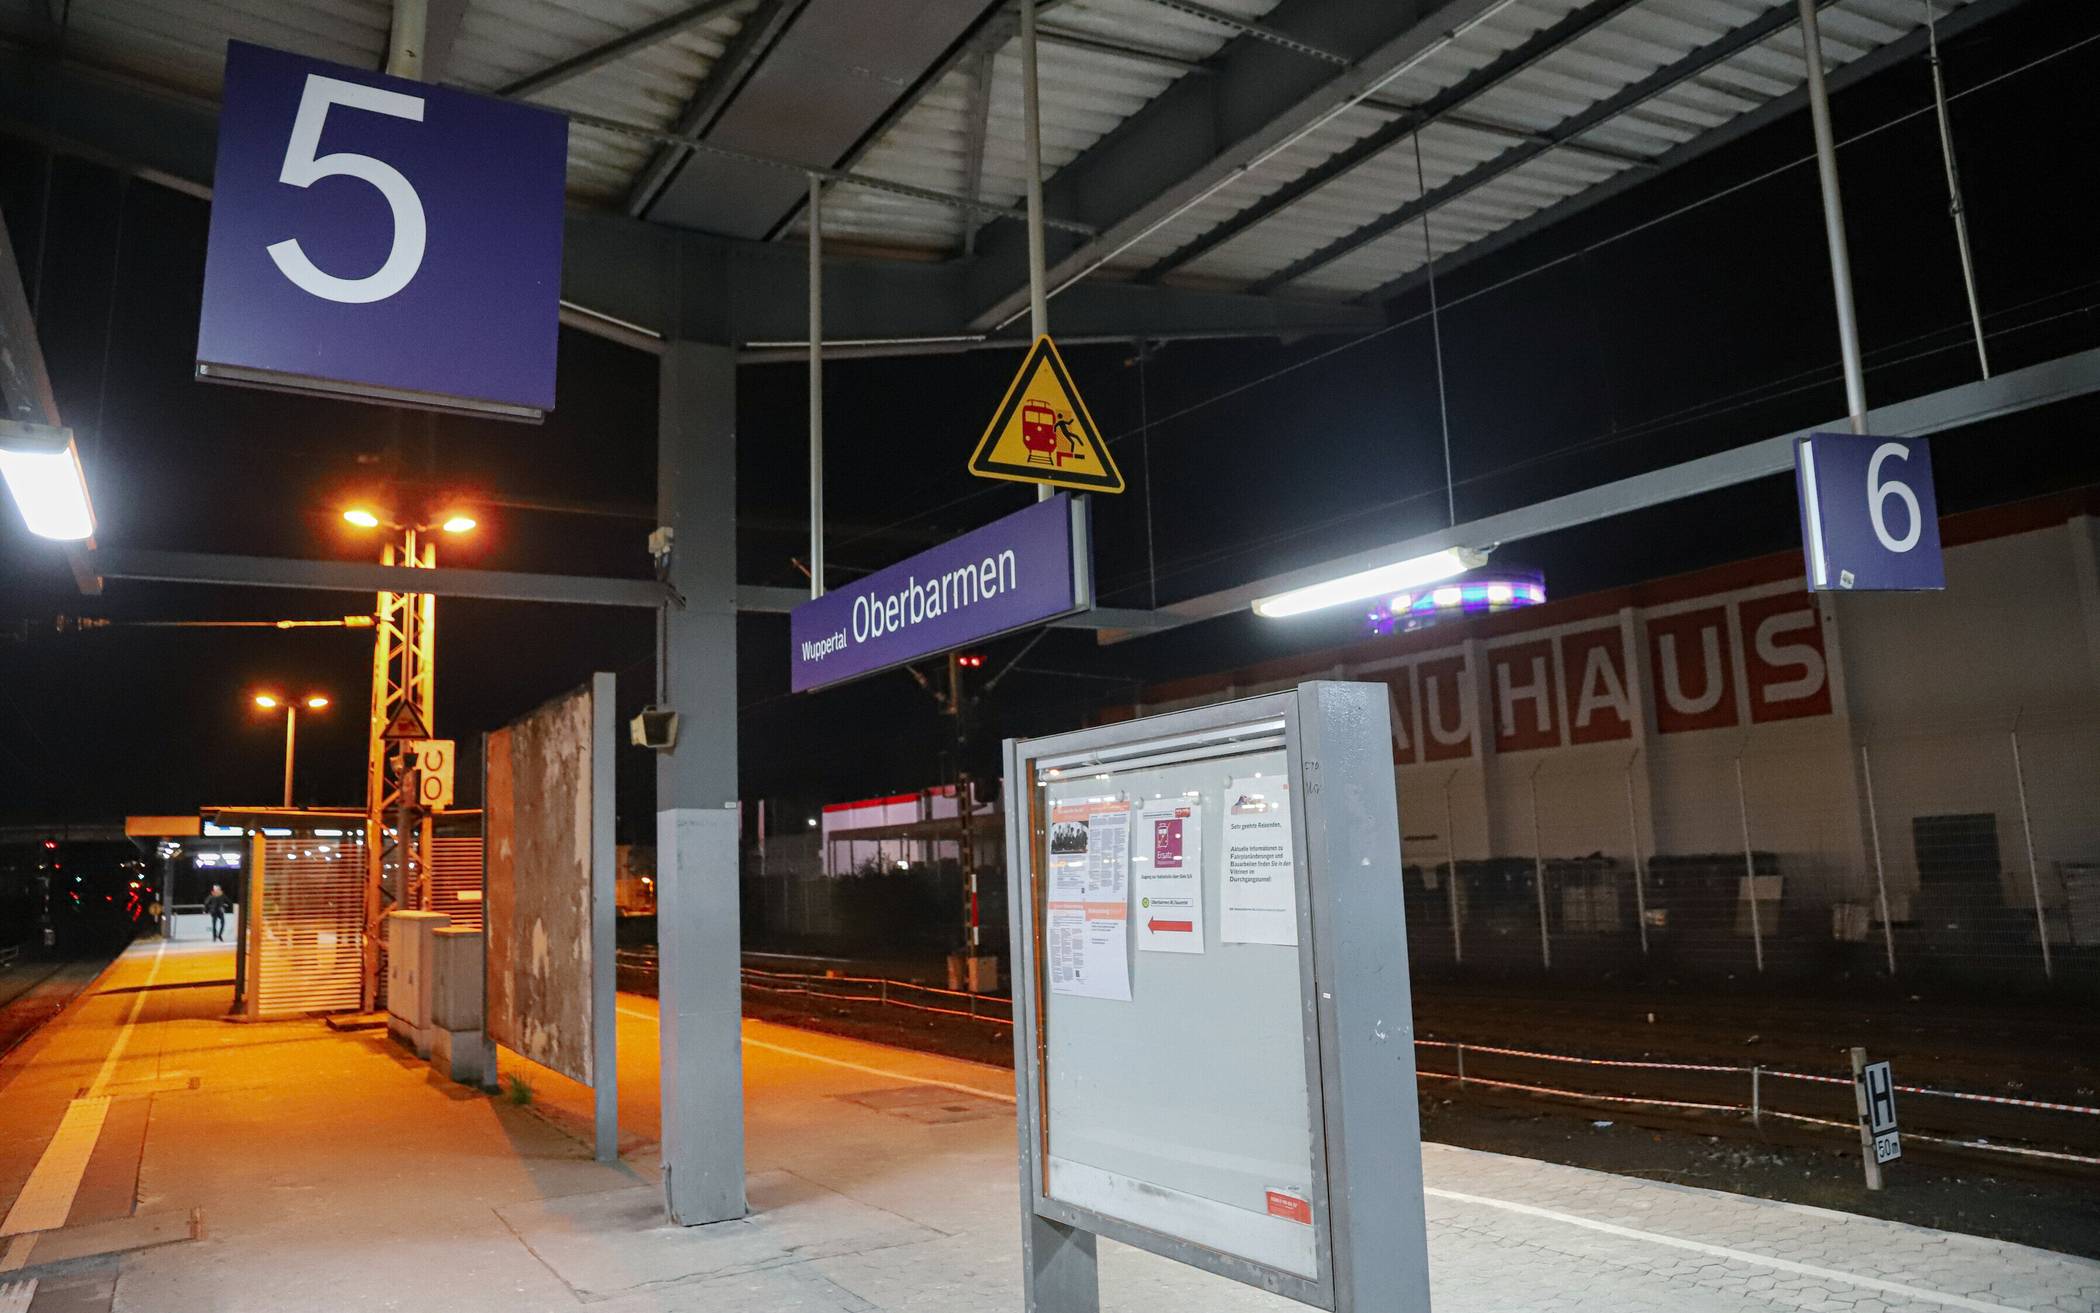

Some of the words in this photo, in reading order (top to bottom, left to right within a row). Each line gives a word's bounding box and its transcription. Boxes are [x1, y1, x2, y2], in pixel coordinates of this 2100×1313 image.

[266, 75, 427, 304] 5
[1867, 442, 1922, 553] 6
[802, 628, 848, 662] Wuppertal
[852, 549, 1016, 643] Oberbarmen
[1869, 1067, 1892, 1126] H
